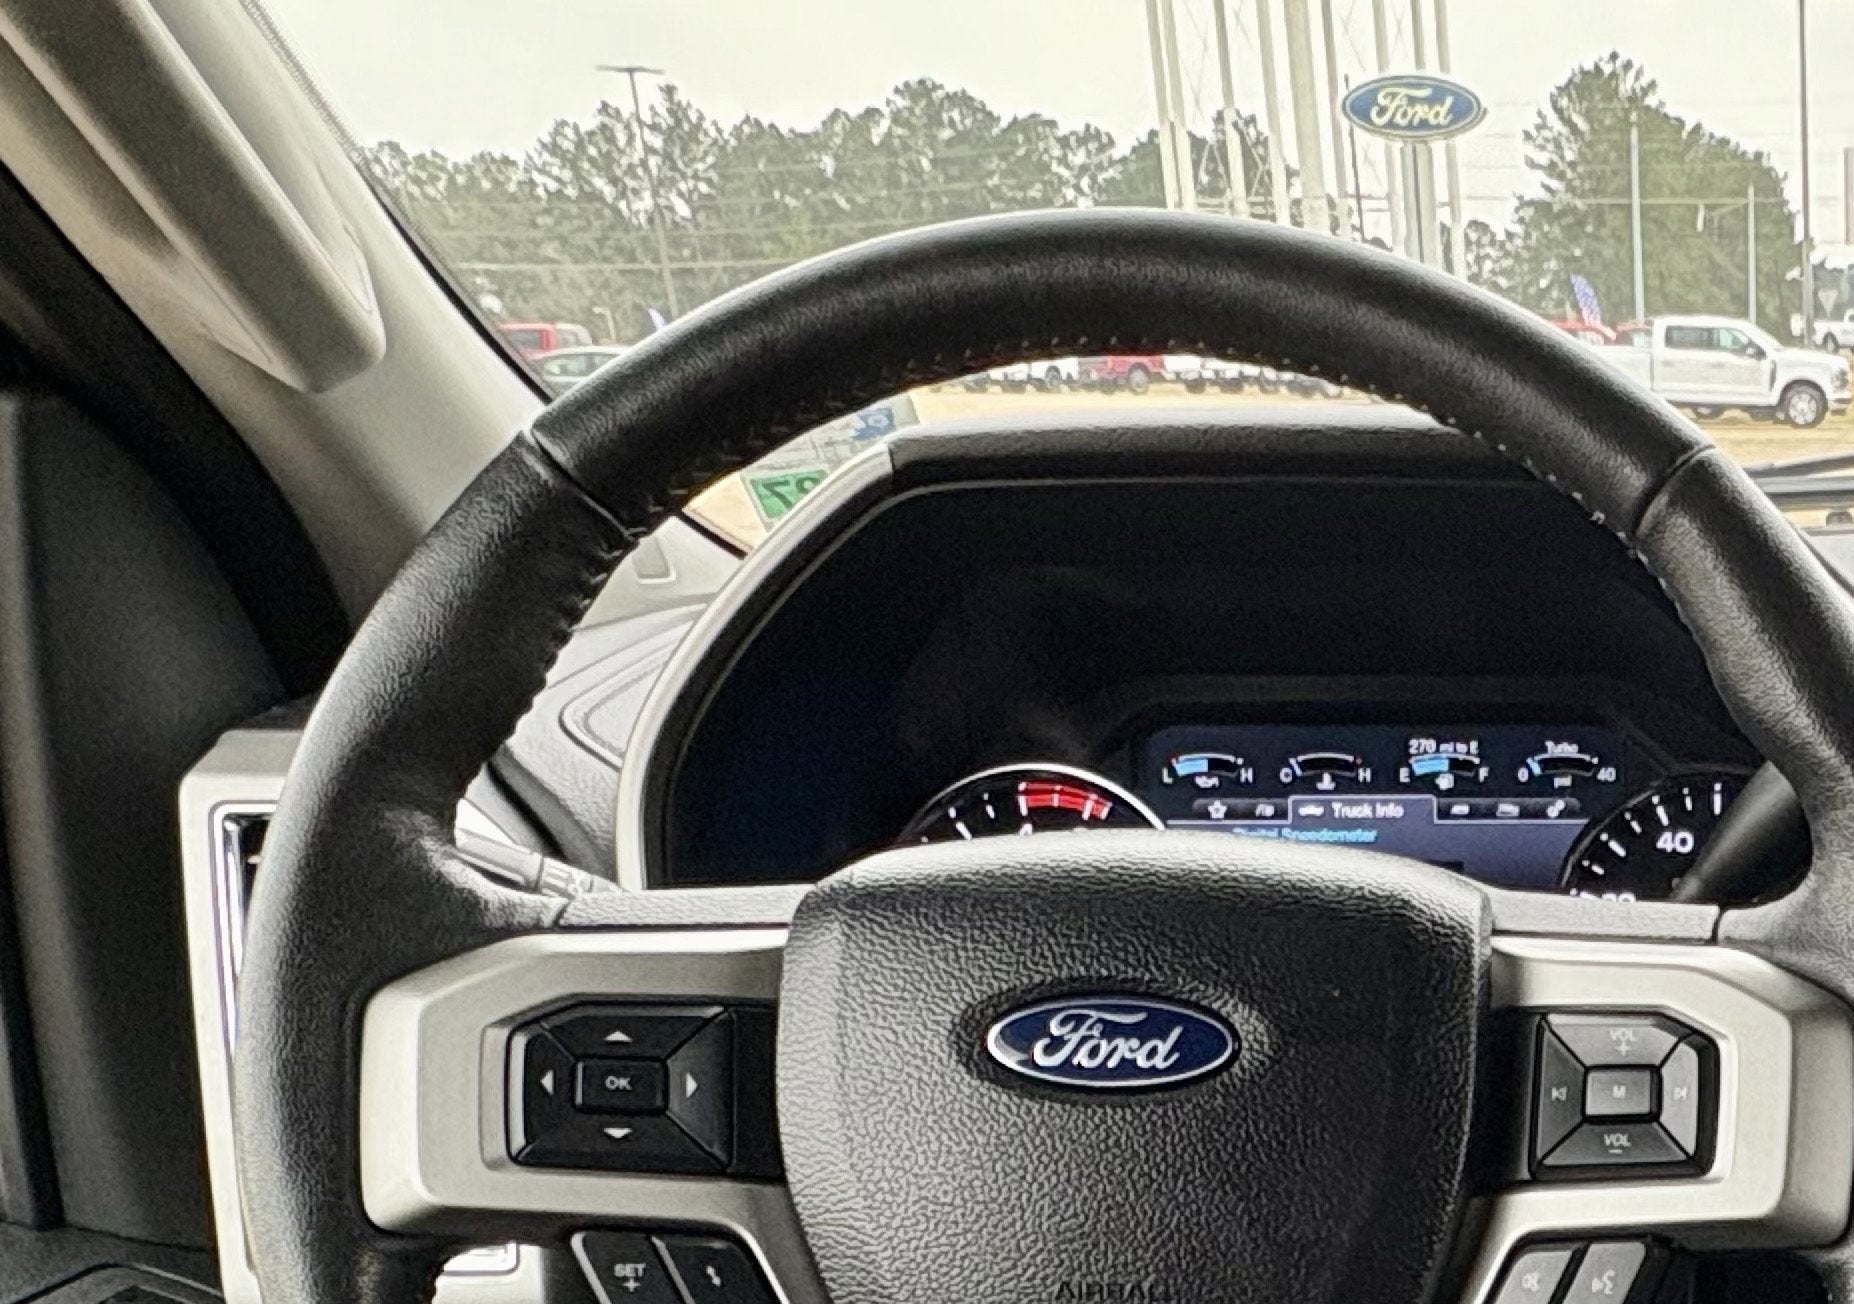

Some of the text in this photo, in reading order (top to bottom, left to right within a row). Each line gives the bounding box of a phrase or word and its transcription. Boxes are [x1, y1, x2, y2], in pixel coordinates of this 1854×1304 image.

[1370, 87, 1454, 127] Ford
[1409, 739, 1437, 754] 270
[1162, 767, 1174, 784] L
[1240, 767, 1254, 783] H
[1358, 767, 1372, 783] H
[1400, 767, 1411, 783] E
[1478, 767, 1490, 783] F
[1597, 767, 1617, 782] 40
[1332, 802, 1404, 818] Truck Info
[1656, 831, 1695, 854] 40
[1032, 1009, 1184, 1070] Ford
[1609, 1029, 1636, 1042] VOL
[605, 1075, 633, 1091] OK
[1612, 1086, 1627, 1099] M
[1604, 1134, 1632, 1147] VOL
[614, 1263, 646, 1277] SET
